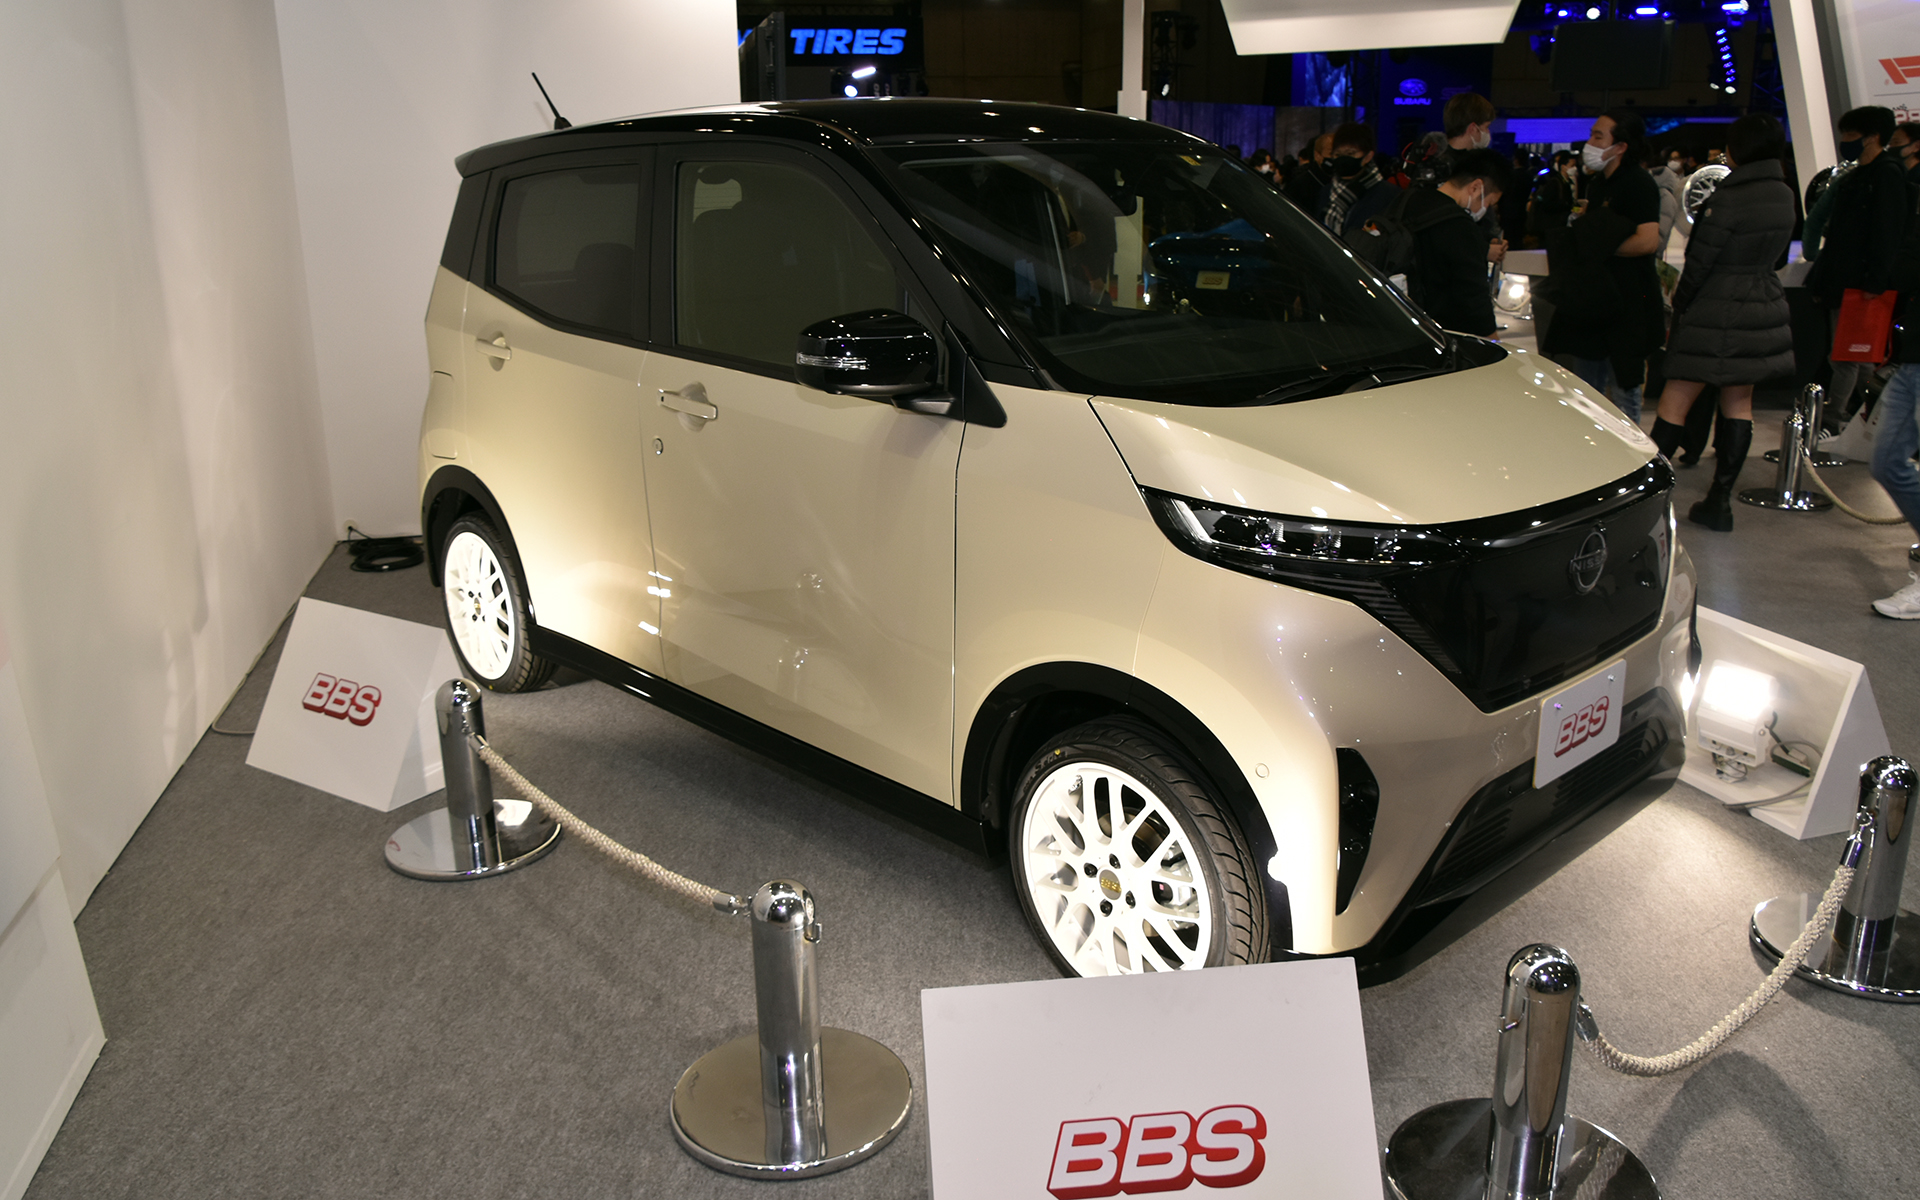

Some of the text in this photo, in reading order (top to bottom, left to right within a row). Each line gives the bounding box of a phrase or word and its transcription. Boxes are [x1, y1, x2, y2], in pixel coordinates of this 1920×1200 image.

[790, 28, 907, 55] TIRES
[1393, 97, 1432, 106] SUBARU
[302, 672, 382, 727] BBS
[1554, 695, 1610, 758] BBS
[1046, 1104, 1268, 1200] BBS
